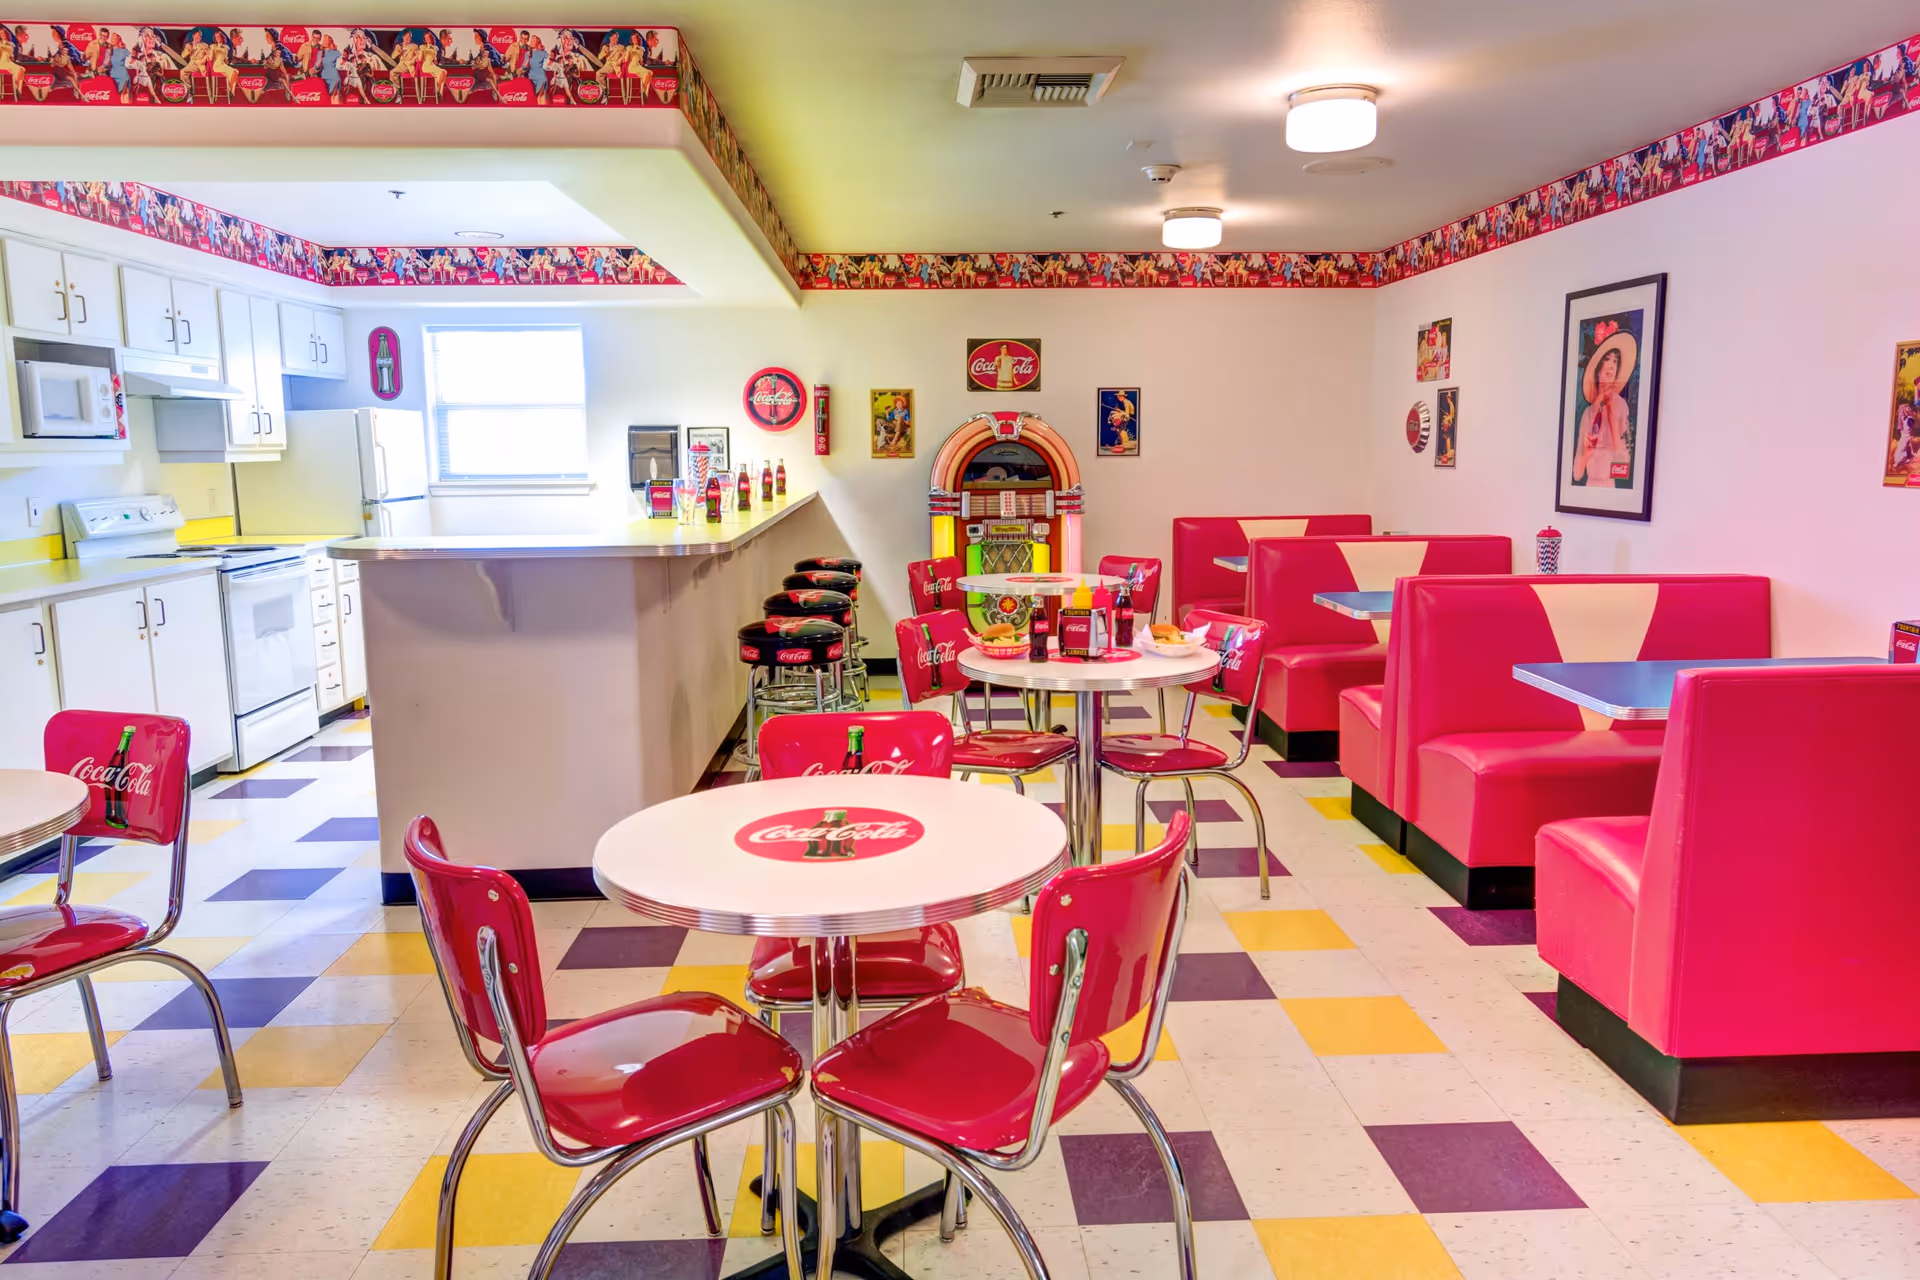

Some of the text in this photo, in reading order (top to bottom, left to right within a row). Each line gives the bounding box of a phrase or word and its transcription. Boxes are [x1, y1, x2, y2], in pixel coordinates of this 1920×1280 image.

[971, 357, 1035, 376] Cocaola
[923, 577, 952, 596] Coca-Cola
[1066, 624, 1088, 632] Coca-Cola
[780, 651, 809, 660] Coca-Cola
[917, 640, 956, 669] Coca-Cola
[69, 757, 155, 796] Coca-Cola
[749, 821, 912, 843] Coca-Cola
